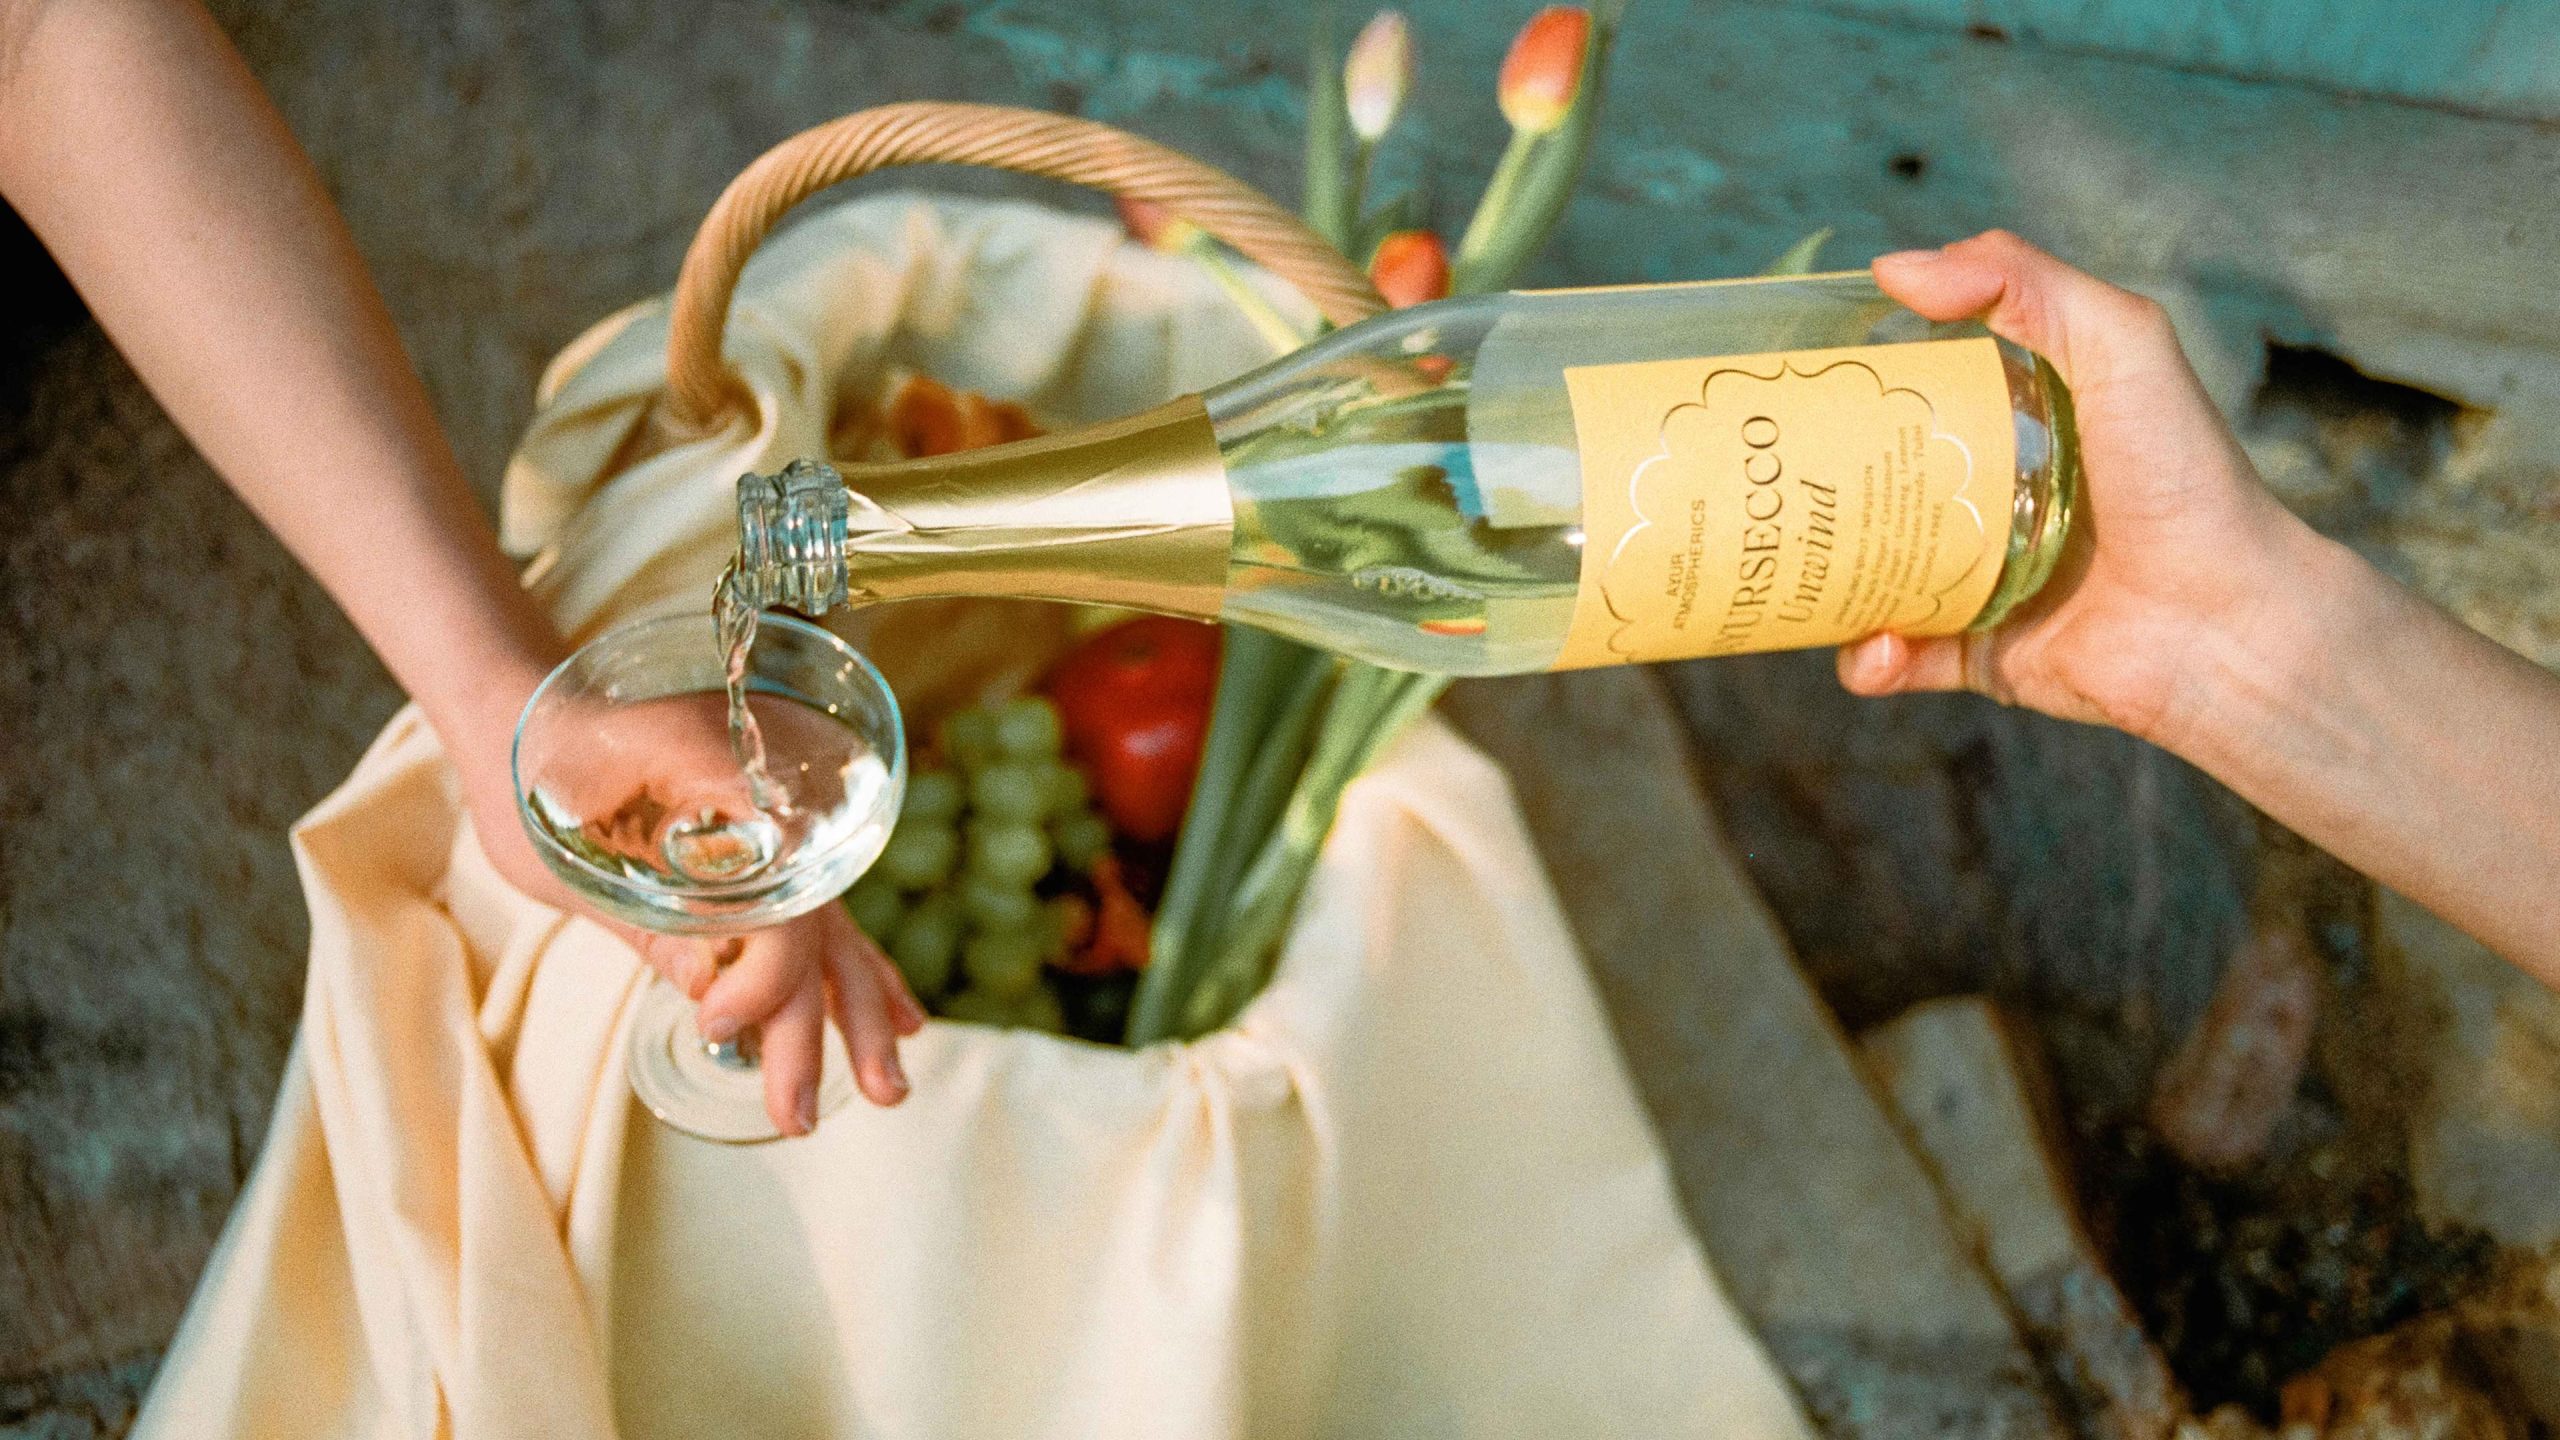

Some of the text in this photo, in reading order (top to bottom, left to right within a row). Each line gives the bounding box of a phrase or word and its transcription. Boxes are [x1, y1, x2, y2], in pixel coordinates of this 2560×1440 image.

[1897, 426, 1908, 473] Lemon
[1882, 451, 1893, 525] Cardamom
[1929, 501, 1944, 537] FREE
[1666, 553, 1685, 596] AYUR
[1673, 499, 1706, 629] ATMOSPHERICS
[1777, 479, 1838, 624] Unwind
